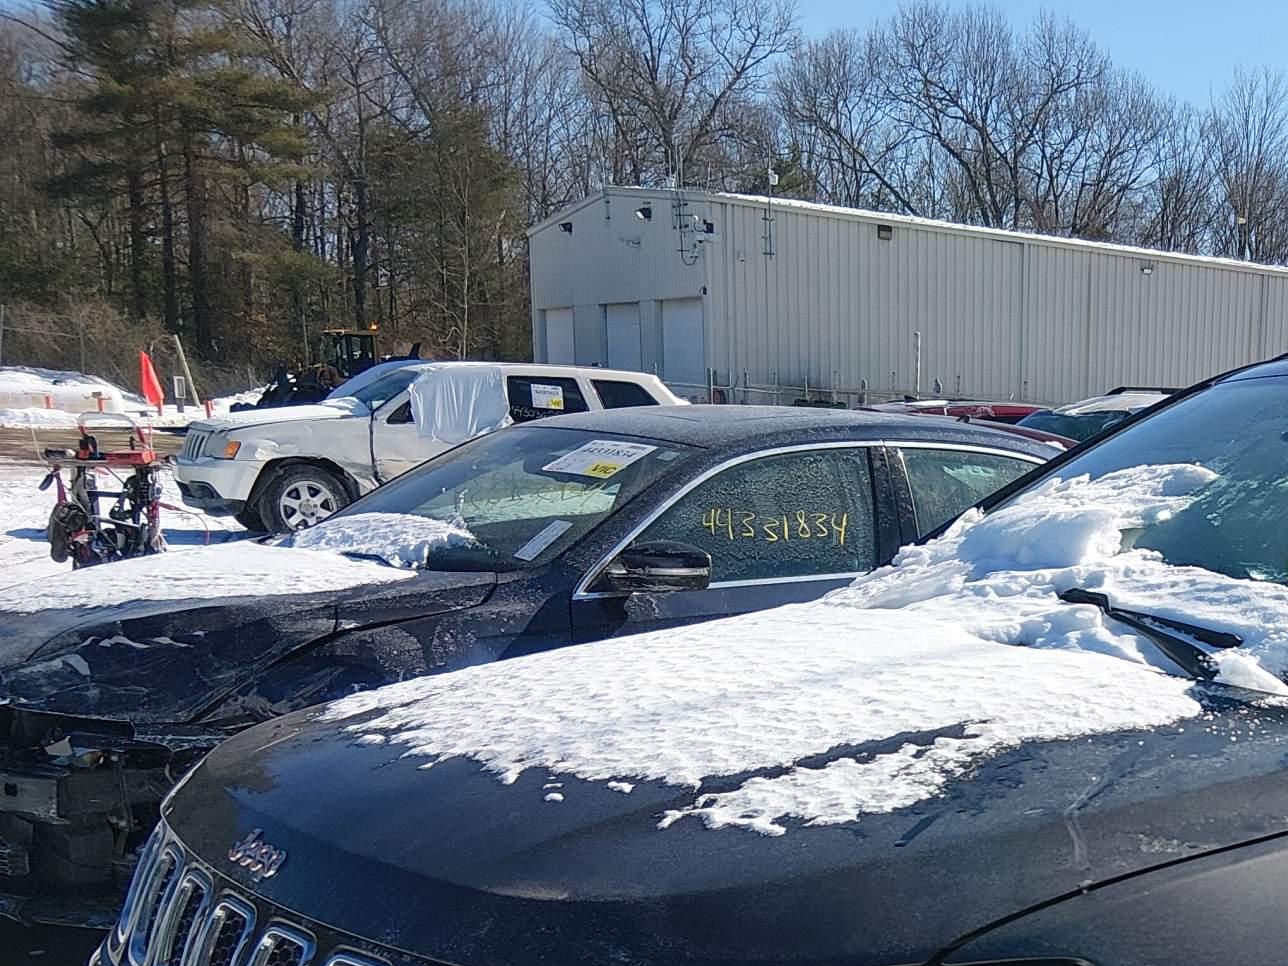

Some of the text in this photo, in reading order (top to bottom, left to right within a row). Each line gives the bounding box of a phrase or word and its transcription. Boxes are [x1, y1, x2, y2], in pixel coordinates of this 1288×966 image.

[592, 464, 617, 474] VIC
[702, 508, 847, 546] 44331834
[228, 828, 287, 879] Jeep
